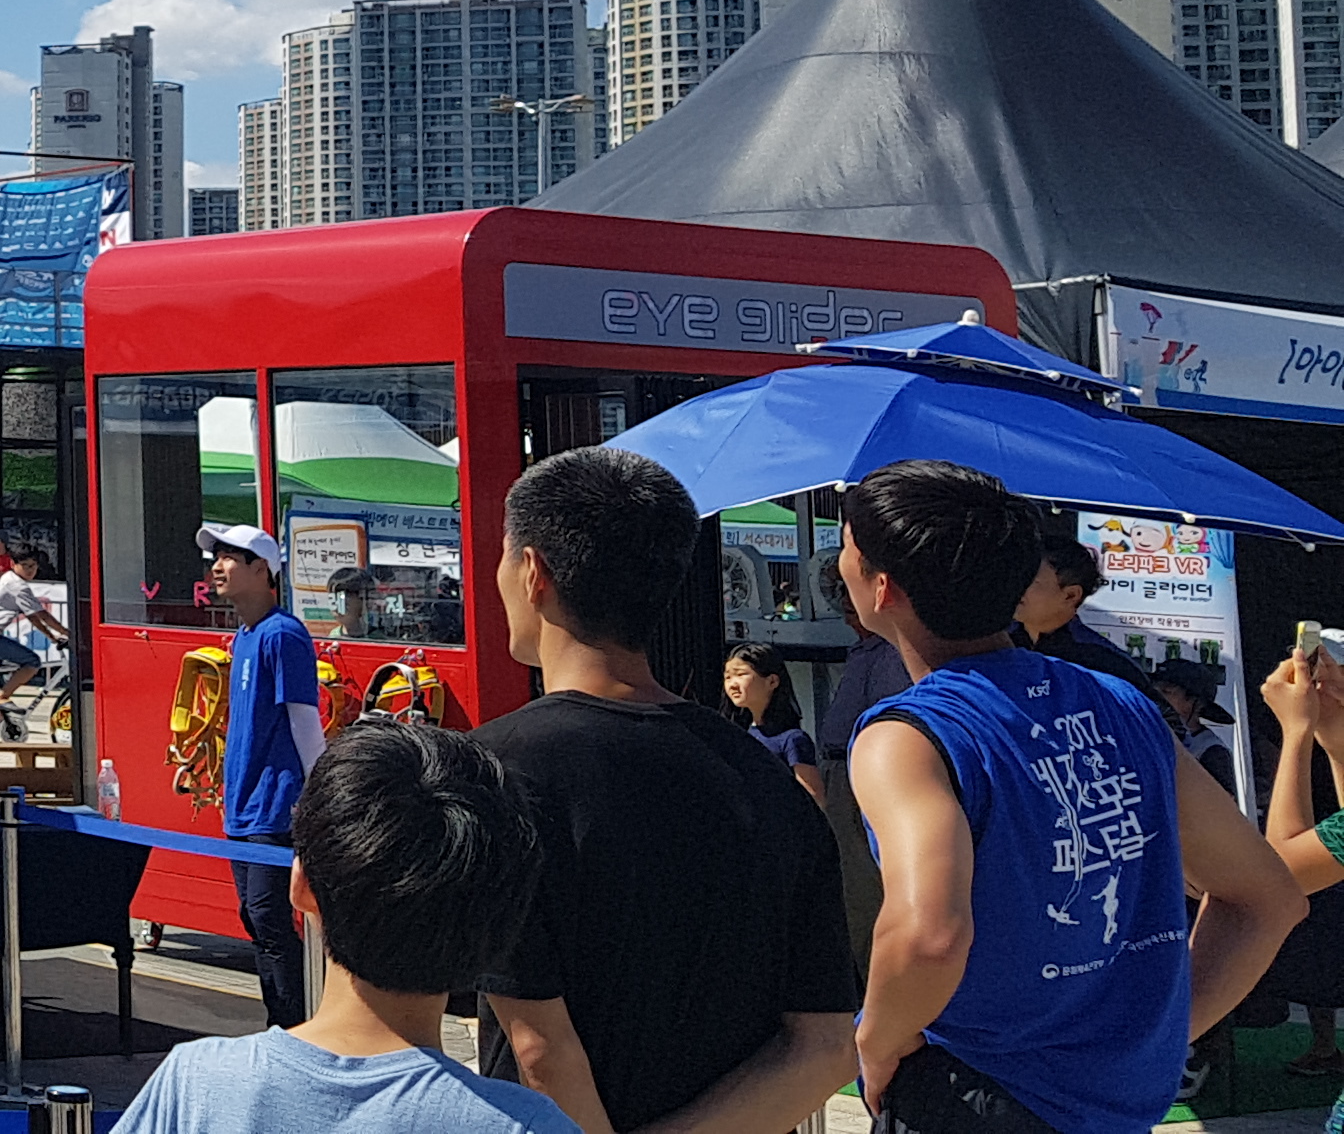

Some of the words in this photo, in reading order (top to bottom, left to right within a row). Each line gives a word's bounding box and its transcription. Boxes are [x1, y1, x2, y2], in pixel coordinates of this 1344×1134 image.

[1107, 553, 1170, 574] 노리파크
[1175, 557, 1204, 575] VR
[1143, 580, 1213, 599] 글라이더
[1054, 710, 1104, 752] 2017
